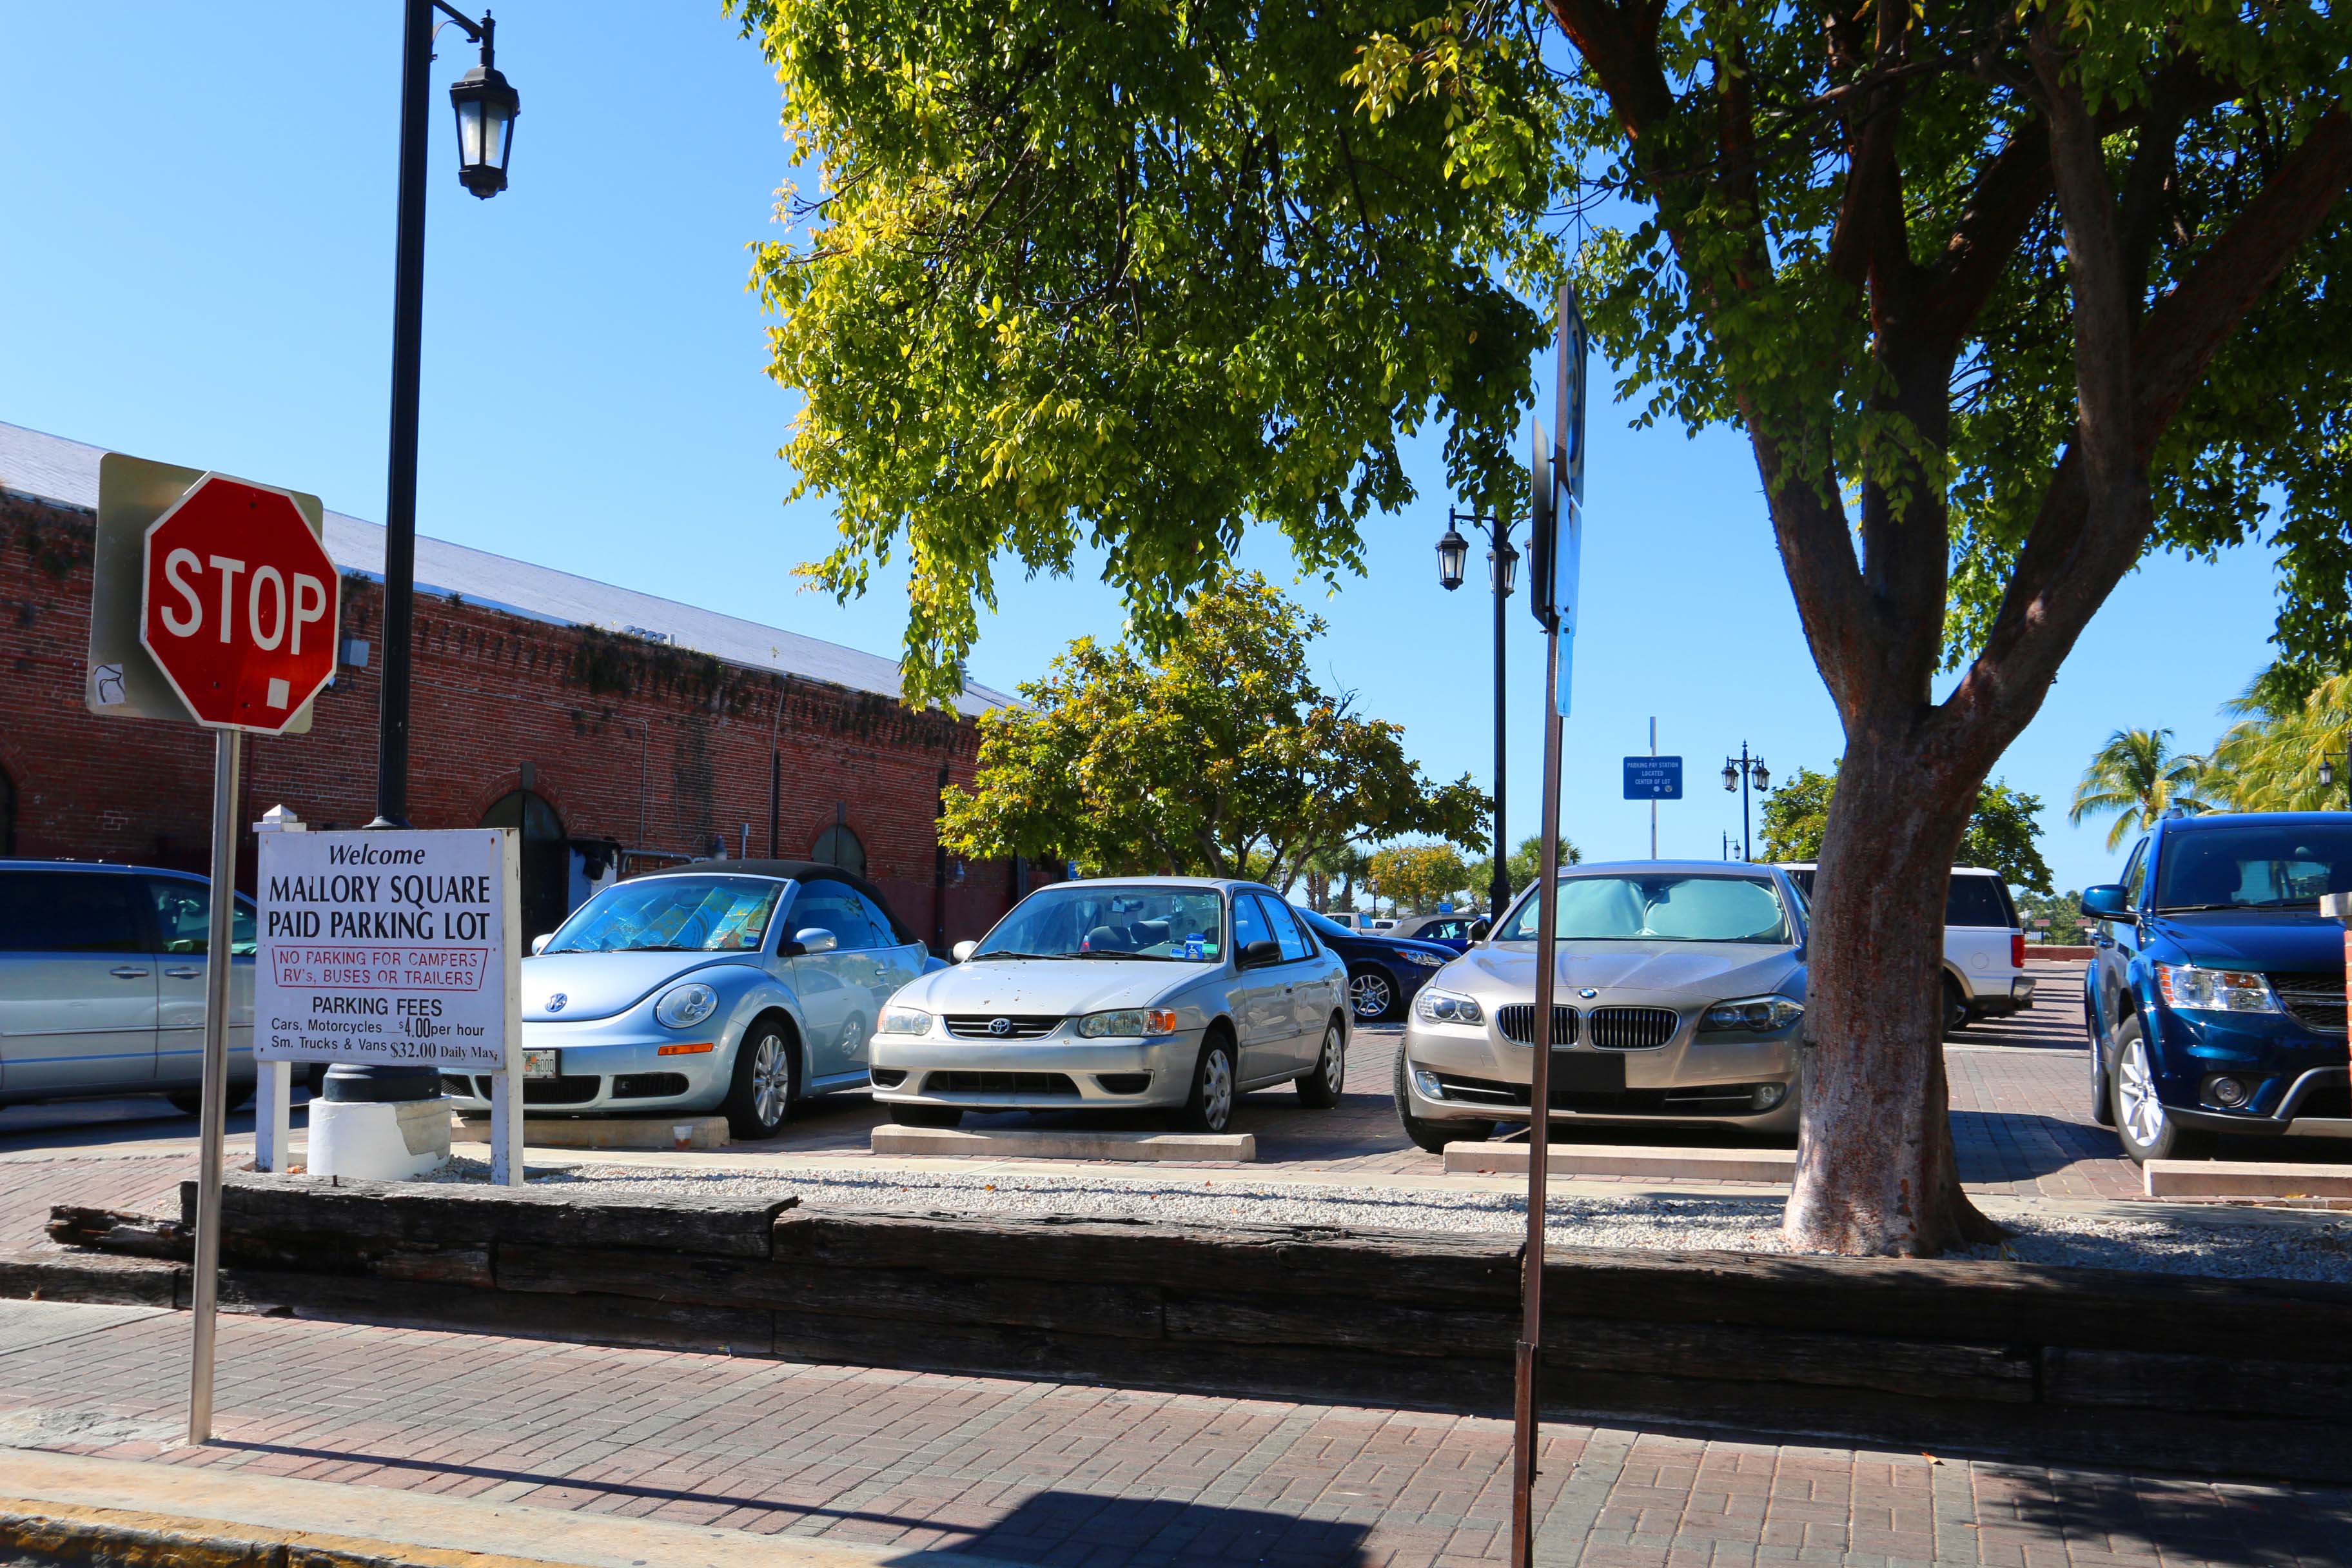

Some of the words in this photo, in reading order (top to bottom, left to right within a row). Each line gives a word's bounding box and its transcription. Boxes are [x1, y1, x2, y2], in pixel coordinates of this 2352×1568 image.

[161, 548, 326, 655] STOP
[329, 843, 425, 865] Welcome
[270, 876, 381, 903] MALLORY
[391, 876, 490, 910] SQUARE
[268, 911, 320, 937] PAID
[330, 912, 433, 940] PARKING
[445, 912, 490, 940] LOT
[279, 951, 300, 964] NO
[306, 952, 366, 965] PARKING
[373, 952, 401, 965] FOR
[409, 953, 477, 966] CAMPERS
[324, 970, 370, 983] BUSES
[378, 970, 398, 984] OR
[405, 971, 473, 985] TRAILERS
[313, 997, 388, 1015] PARKING
[397, 999, 443, 1017] FEES
[271, 1018, 302, 1032] Cars,
[308, 1020, 382, 1034] Motorcycles
[431, 1024, 450, 1036] per
[457, 1024, 485, 1036] hour
[271, 1036, 293, 1048] Sm.
[299, 1037, 338, 1050] Trucks
[344, 1039, 352, 1050] &
[358, 1039, 387, 1051] Vans
[390, 1043, 436, 1059] $32.00
[440, 1046, 467, 1057] Daily
